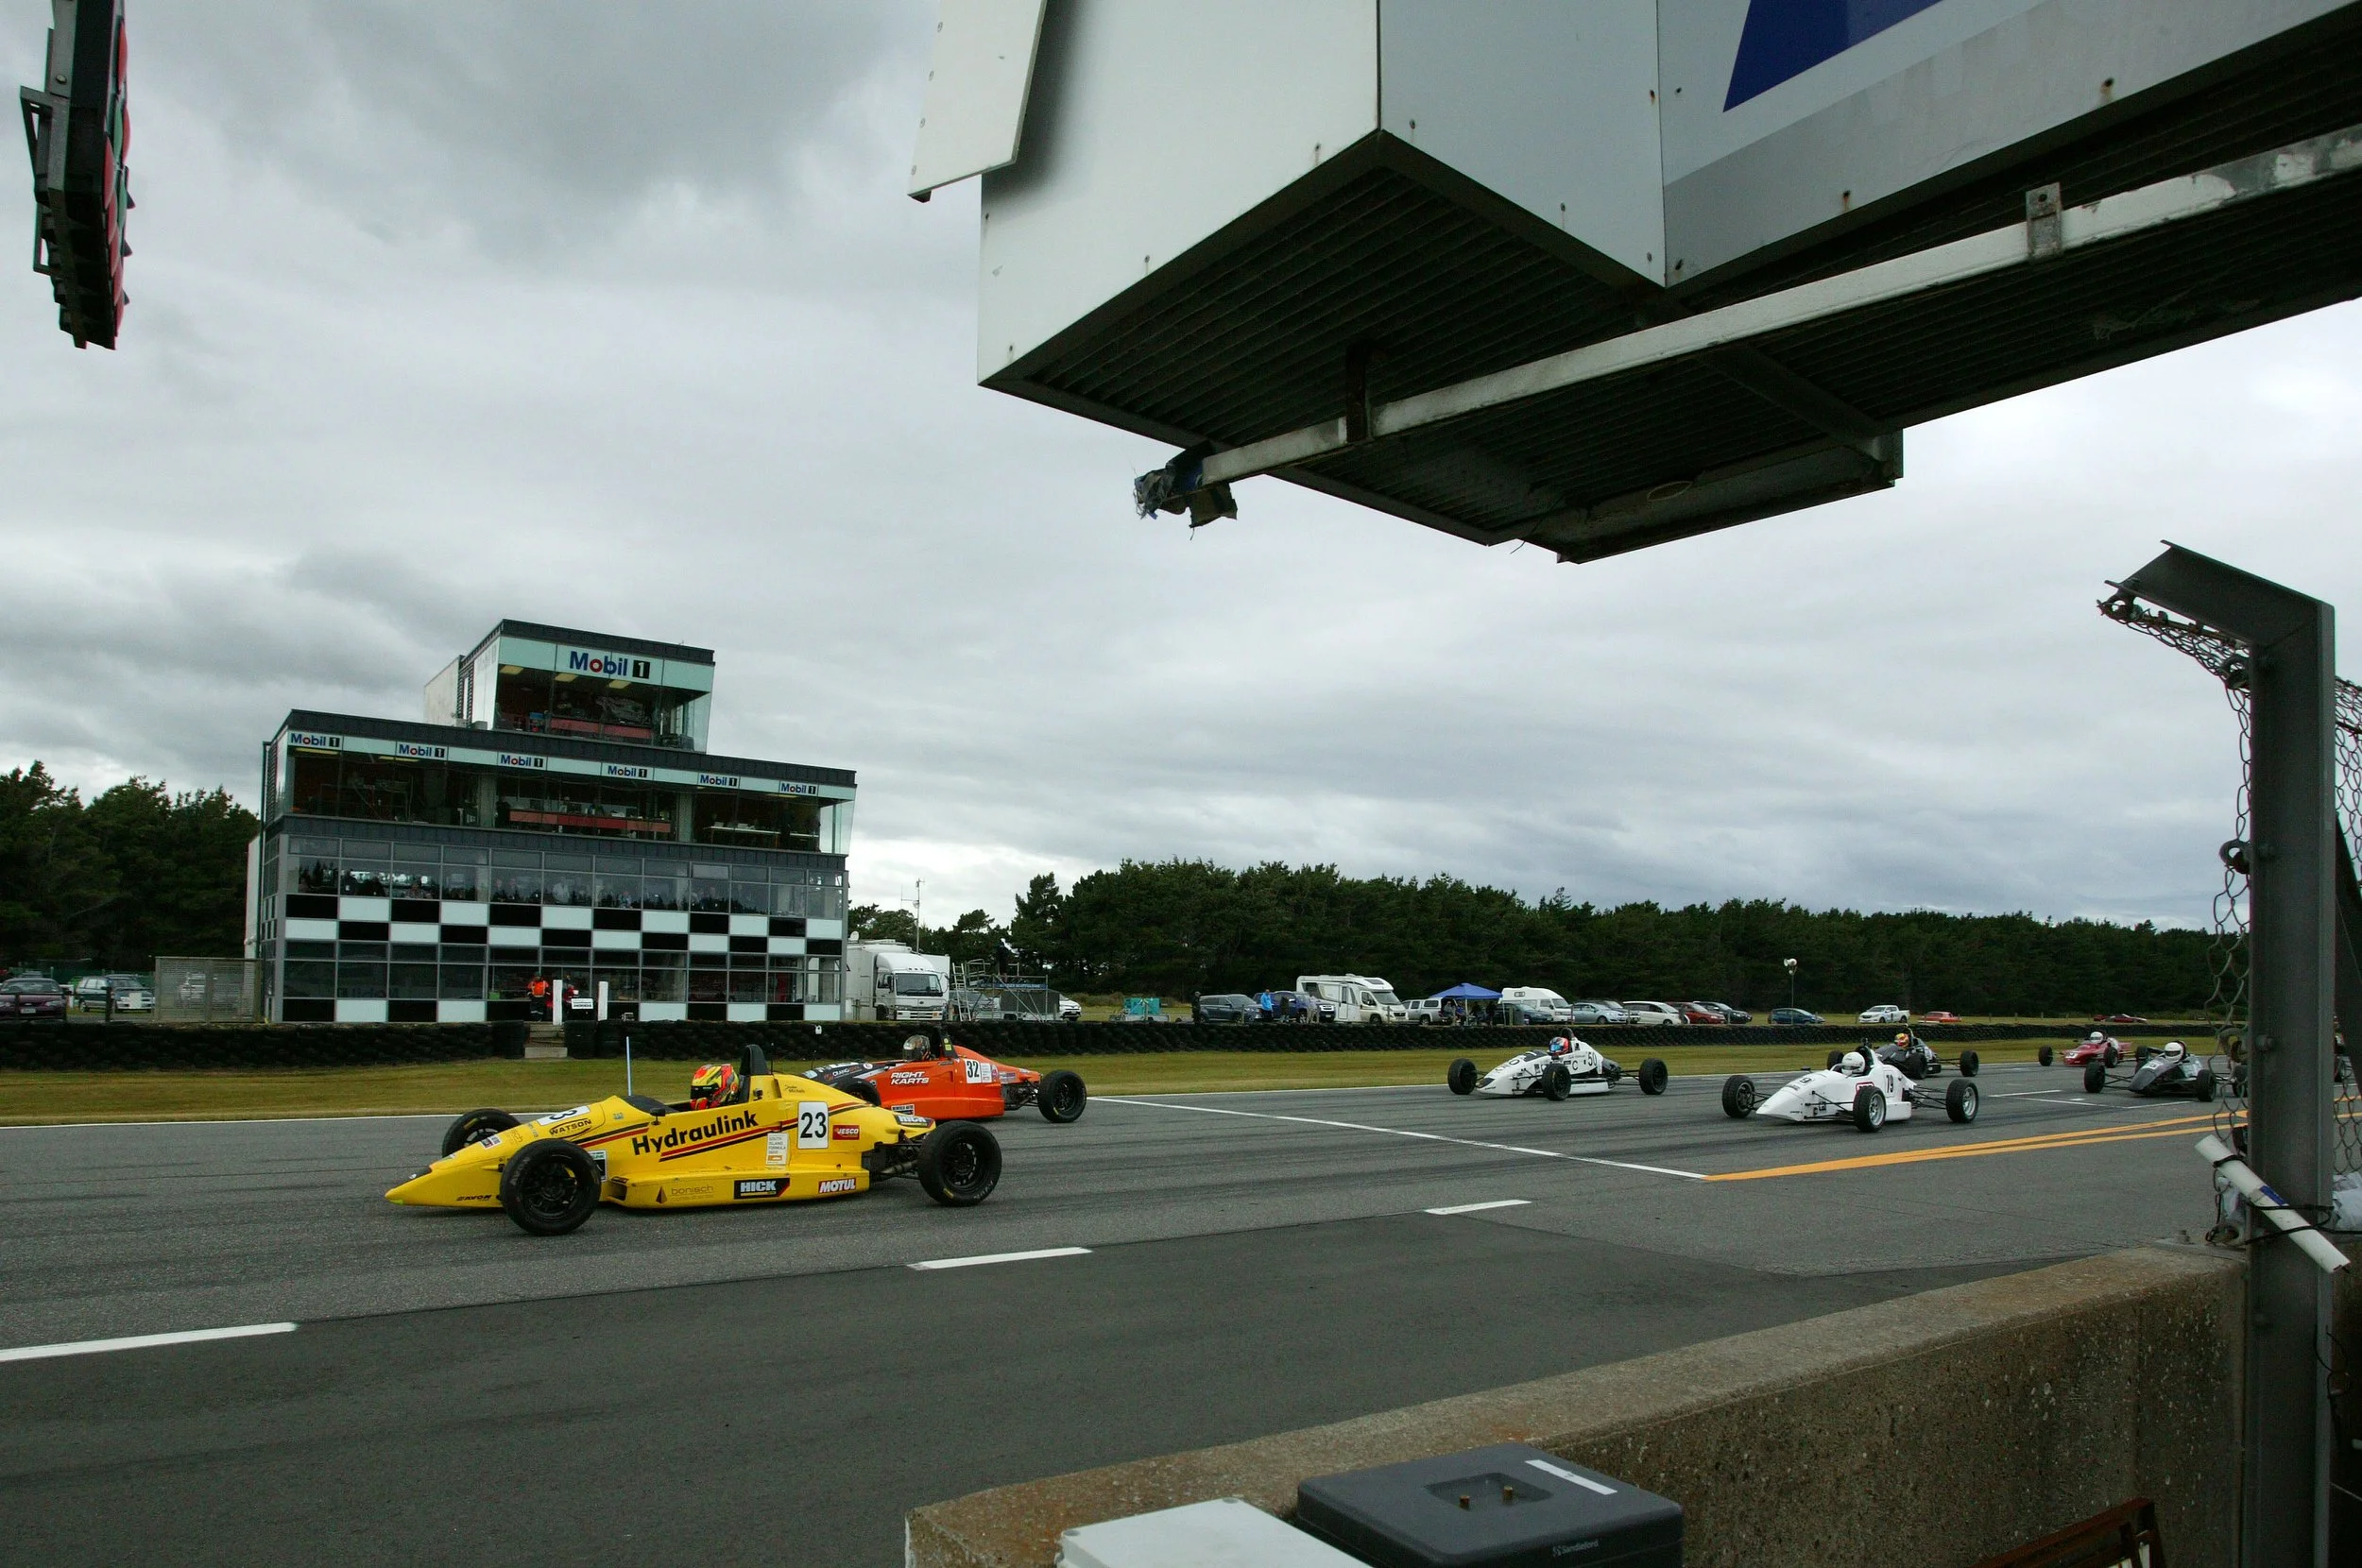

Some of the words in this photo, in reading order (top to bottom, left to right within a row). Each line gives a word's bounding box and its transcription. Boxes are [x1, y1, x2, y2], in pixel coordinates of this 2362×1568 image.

[570, 651, 627, 675] Mobil
[291, 733, 326, 746] Mobil
[399, 744, 432, 757] Mobil
[501, 755, 531, 766] Mobil
[608, 766, 636, 777] Mobil
[700, 775, 727, 786] Mobil
[781, 783, 806, 793] Mobil
[966, 1060, 980, 1078] 32
[549, 1118, 592, 1135] WATSON
[800, 1112, 827, 1139] 23
[631, 1110, 759, 1155] Hydraulink
[740, 1181, 777, 1192] HICK
[819, 1179, 856, 1193] MOTUL
